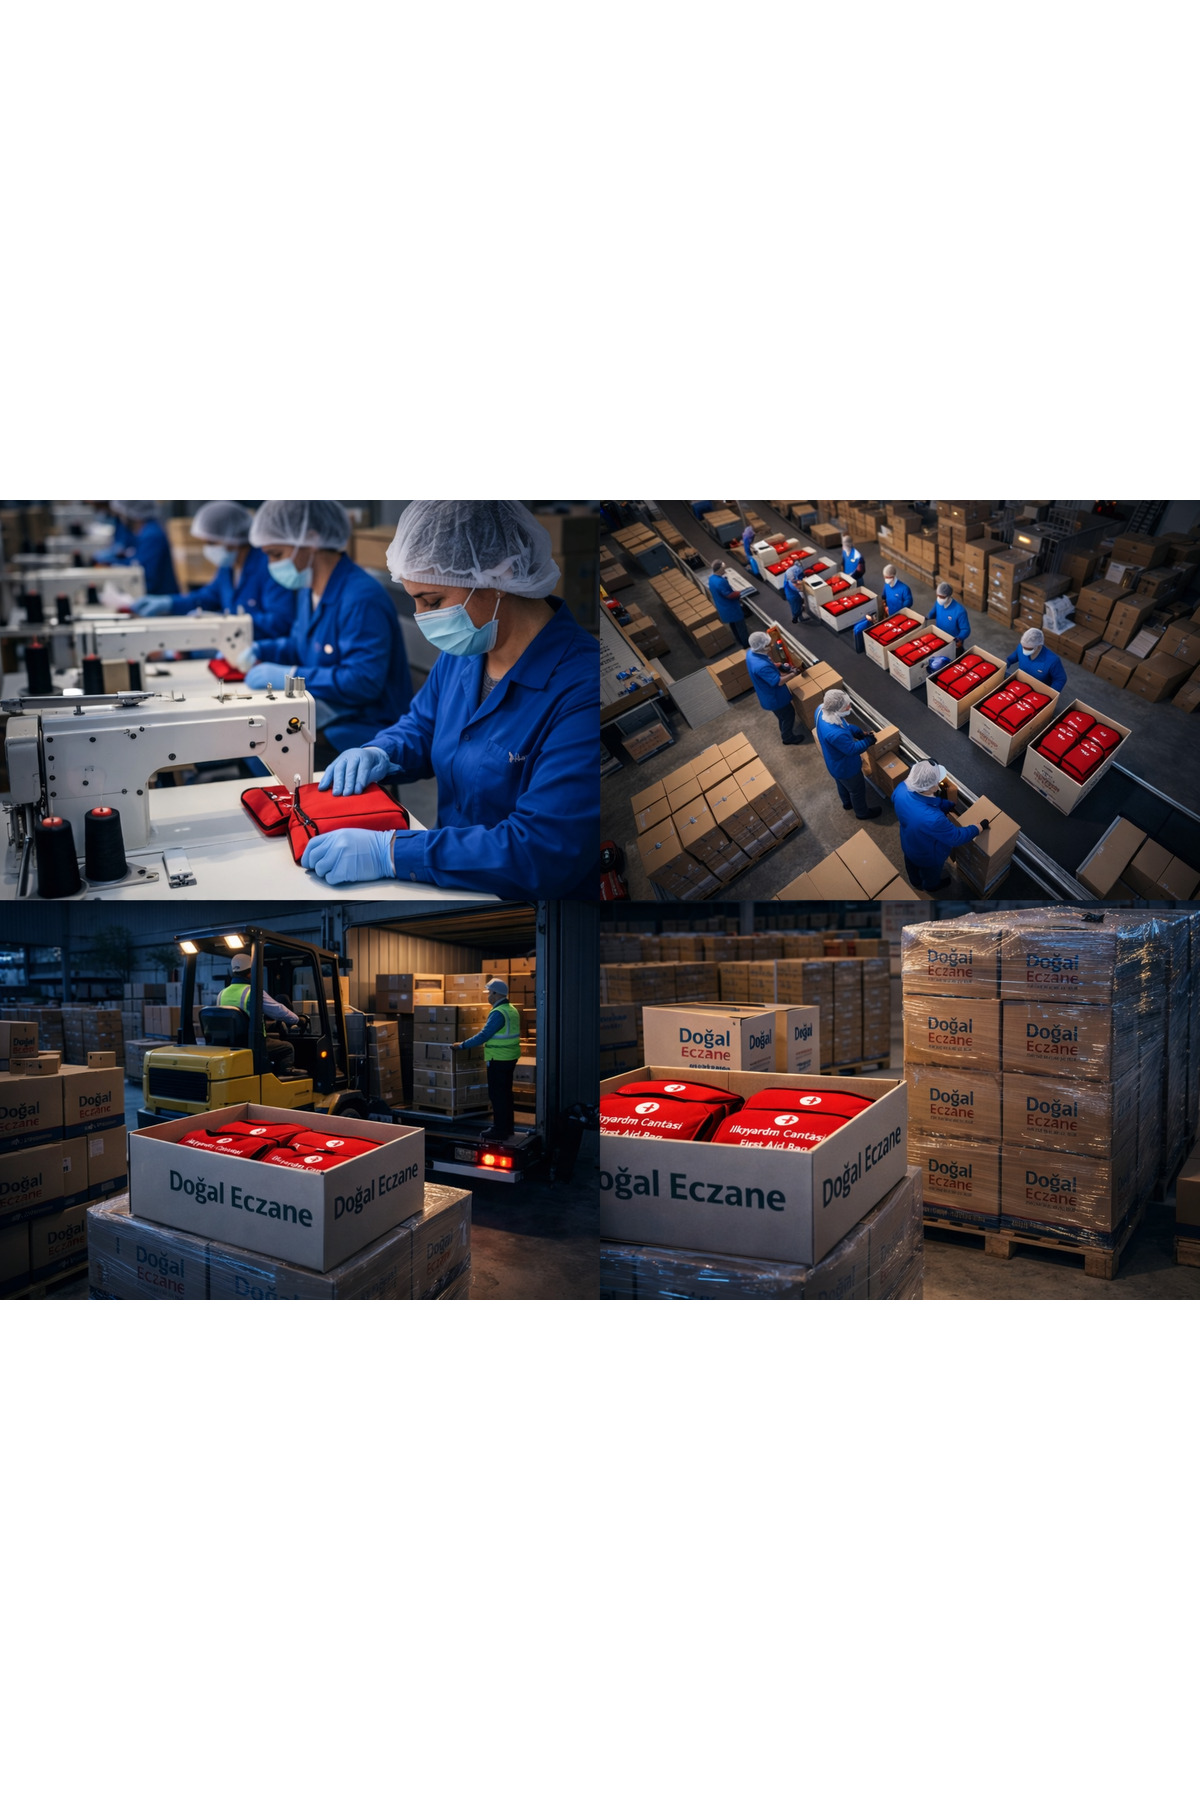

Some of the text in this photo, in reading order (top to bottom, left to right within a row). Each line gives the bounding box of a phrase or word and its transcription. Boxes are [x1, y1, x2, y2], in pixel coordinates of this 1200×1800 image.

[928, 948, 973, 967] Doğal
[928, 965, 973, 978] Eczane
[1026, 971, 1079, 984] Eczane
[928, 1017, 973, 1035] Doğal
[1026, 1023, 1078, 1043] Doğal
[679, 1028, 731, 1049] Doğal
[749, 1028, 772, 1050] Doğal
[928, 1032, 973, 1046] Eczane
[1026, 1040, 1078, 1055] Eczane
[681, 1046, 731, 1061] Eczane
[79, 1091, 112, 1107] Doğal
[929, 1087, 974, 1107] Doğal
[1026, 1096, 1078, 1118] Doğal
[930, 1104, 975, 1119] Eczane
[1026, 1114, 1078, 1131] Eczane
[765, 1140, 786, 1149] Aid
[822, 1126, 902, 1209] Doğal Eczane
[928, 1159, 973, 1179] Doğal
[0, 1172, 42, 1196] Doğal
[334, 1162, 419, 1221] Doğal Eczane
[669, 1172, 787, 1211] Eczane
[928, 1175, 973, 1192] Eczane
[169, 1170, 313, 1227] Doğal Eczane
[1025, 1187, 1078, 1207] Eczane
[48, 1220, 84, 1246] Doğal
[136, 1245, 185, 1278] Doğal
[137, 1265, 185, 1295] Eczane
